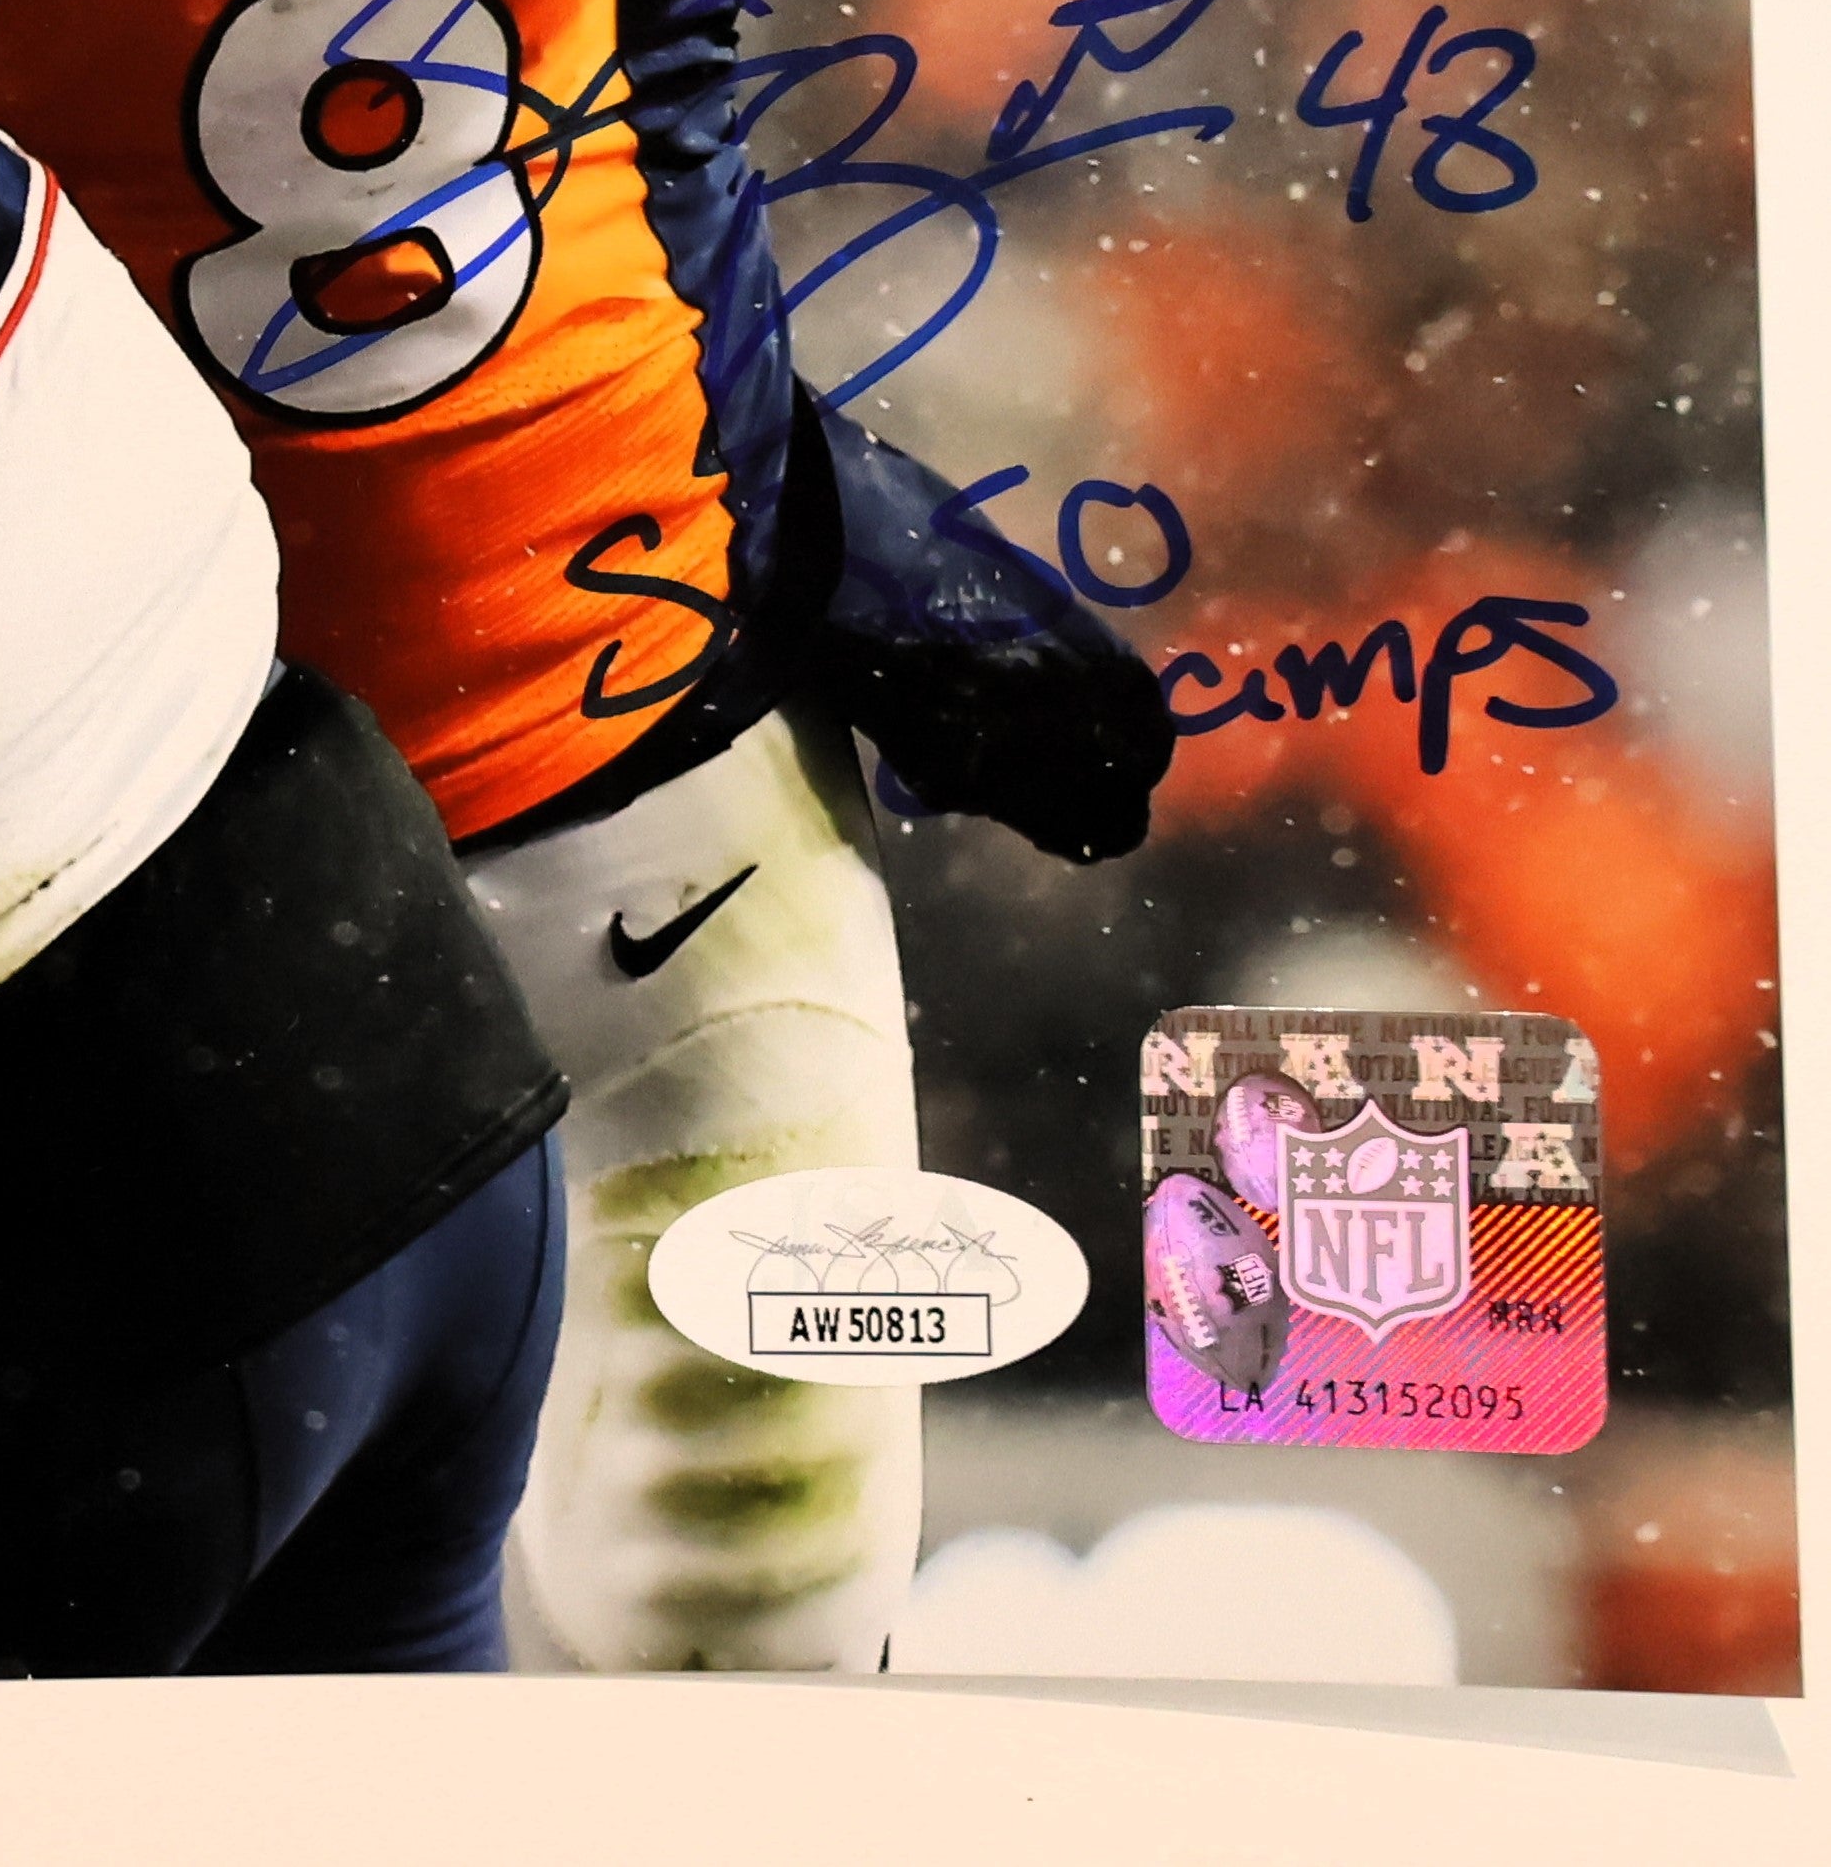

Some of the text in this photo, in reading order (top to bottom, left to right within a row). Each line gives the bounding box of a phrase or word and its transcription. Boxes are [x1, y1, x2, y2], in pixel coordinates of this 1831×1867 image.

[1304, 1207, 1446, 1304] NFL
[1218, 1379, 1524, 1421] LA 413152095
